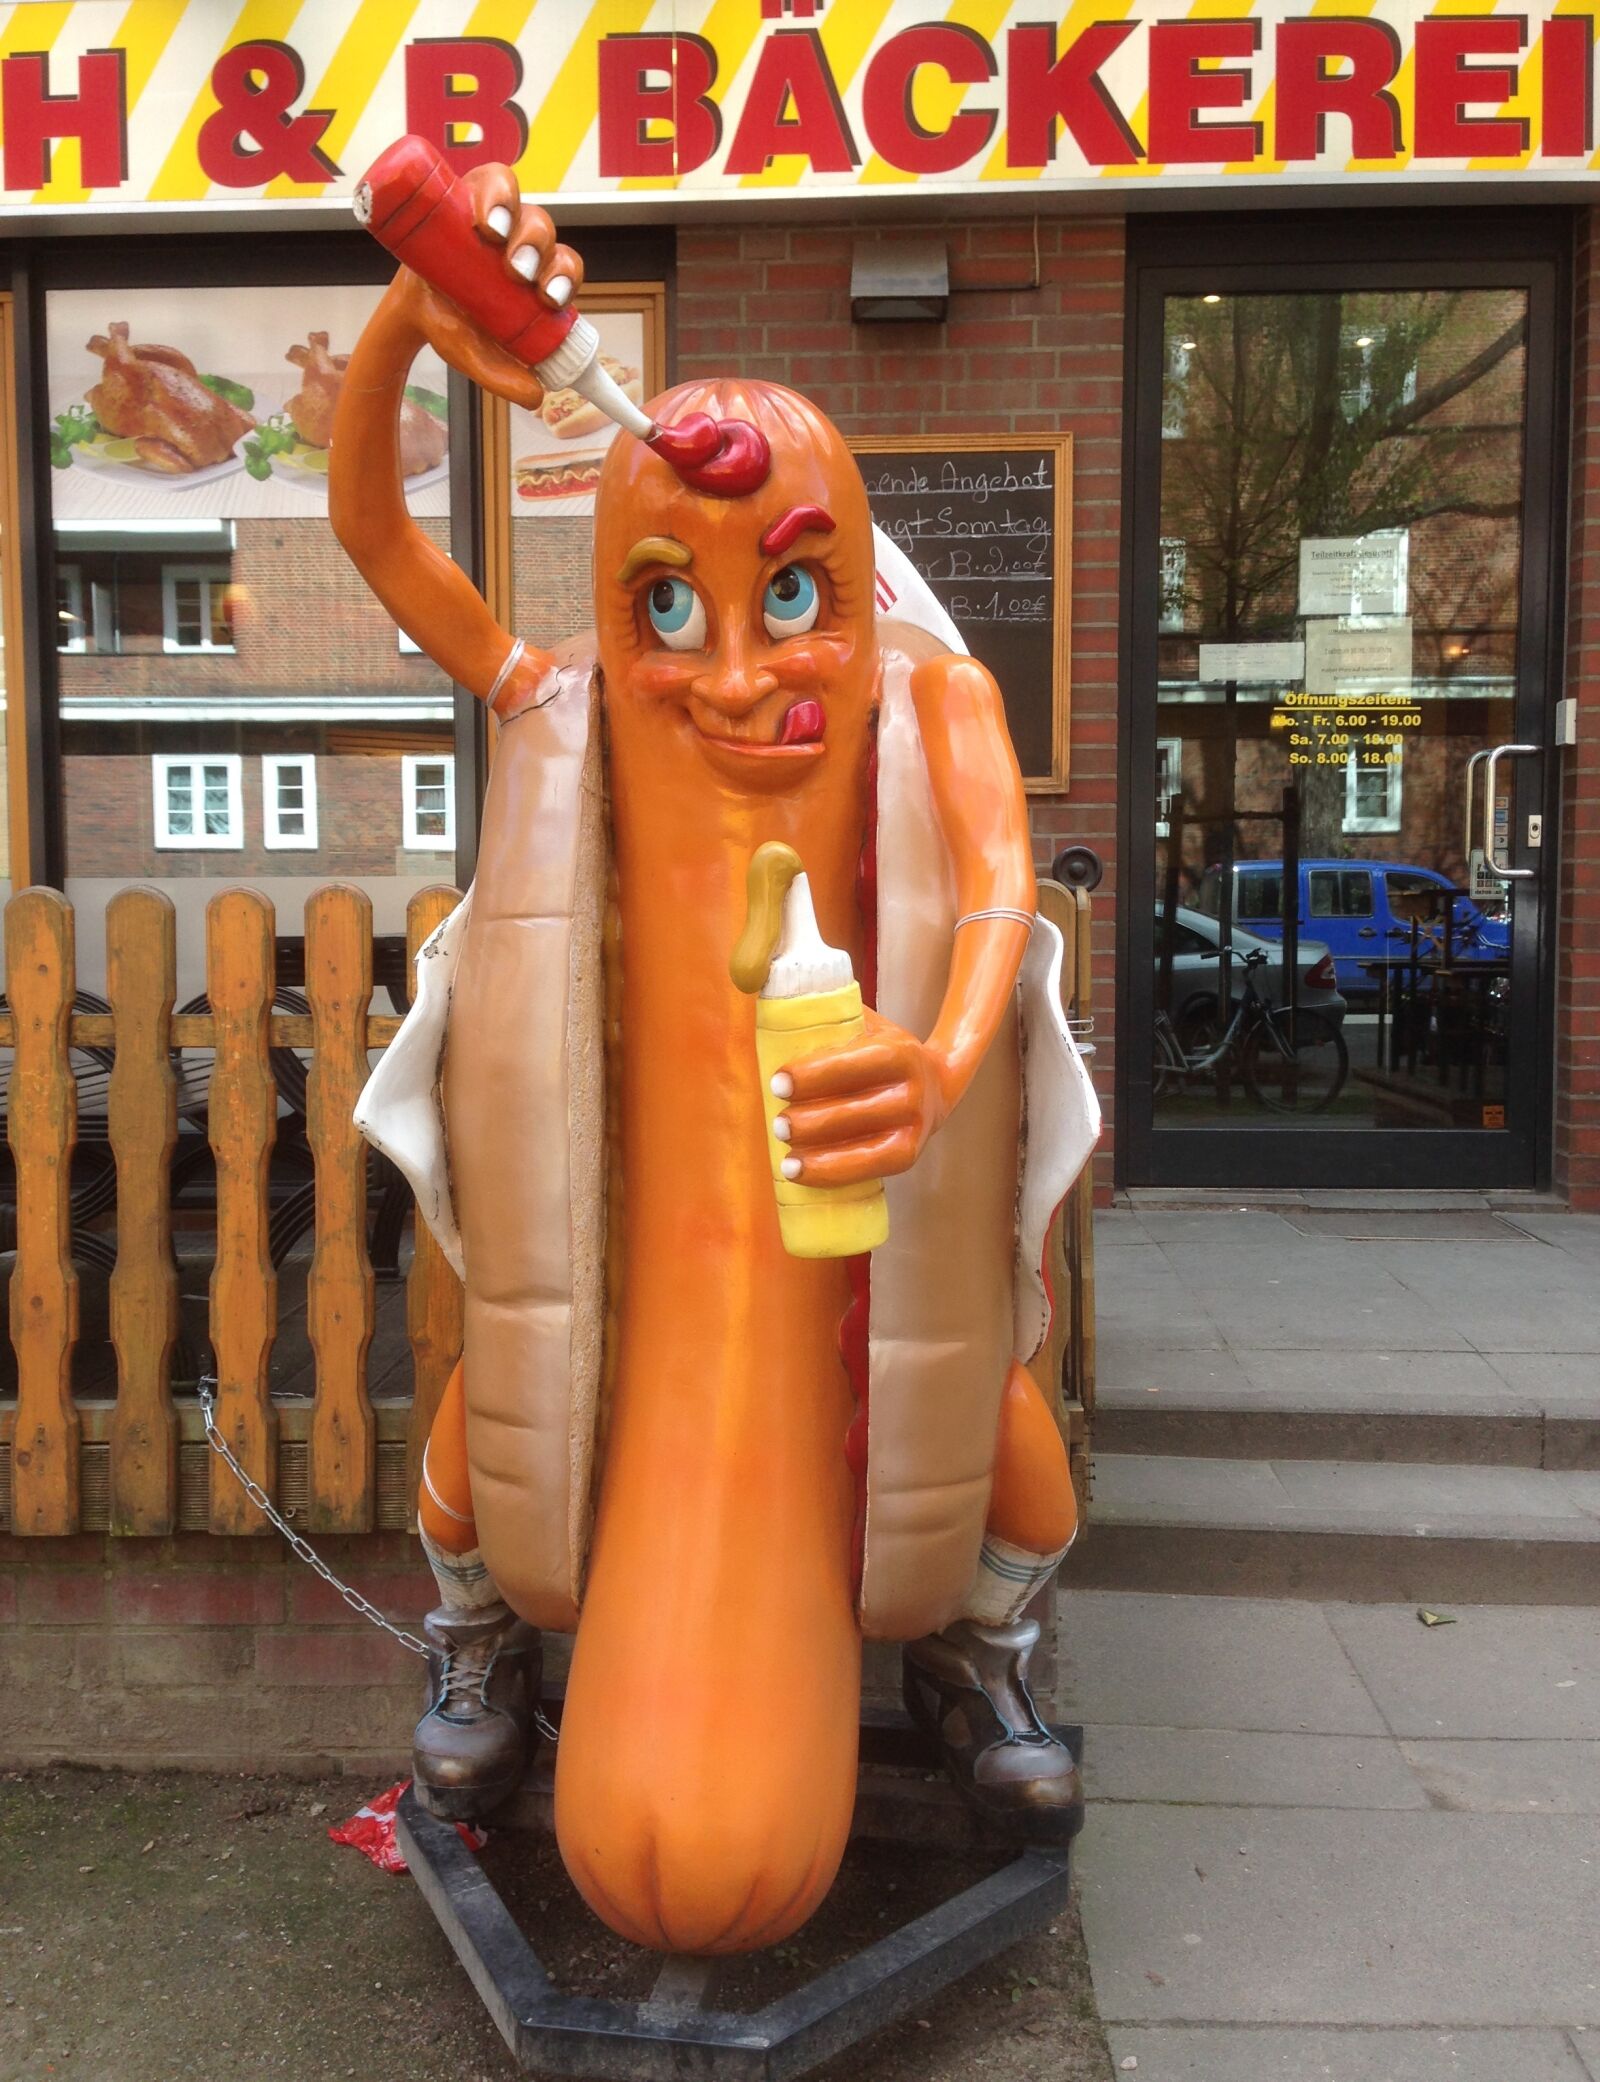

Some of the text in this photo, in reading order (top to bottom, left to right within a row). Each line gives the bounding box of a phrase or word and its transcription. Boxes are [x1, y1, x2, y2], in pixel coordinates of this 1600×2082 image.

[1, 0, 1594, 191] H & B BÄCKEREI
[941, 459, 1048, 503] Angebot
[934, 507, 1048, 553] Sonntag
[1284, 690, 1412, 707] Öffnungszeiten:
[1313, 715, 1330, 726] Fr.
[1335, 715, 1367, 726] 6.00
[1381, 715, 1422, 726] 19.00
[1289, 734, 1313, 745] Sa.
[1318, 734, 1349, 745] 7.00
[1363, 734, 1403, 745] 18.00
[1289, 753, 1312, 764] So.
[1317, 753, 1348, 764] 8.00
[1362, 753, 1403, 764] 18.00
